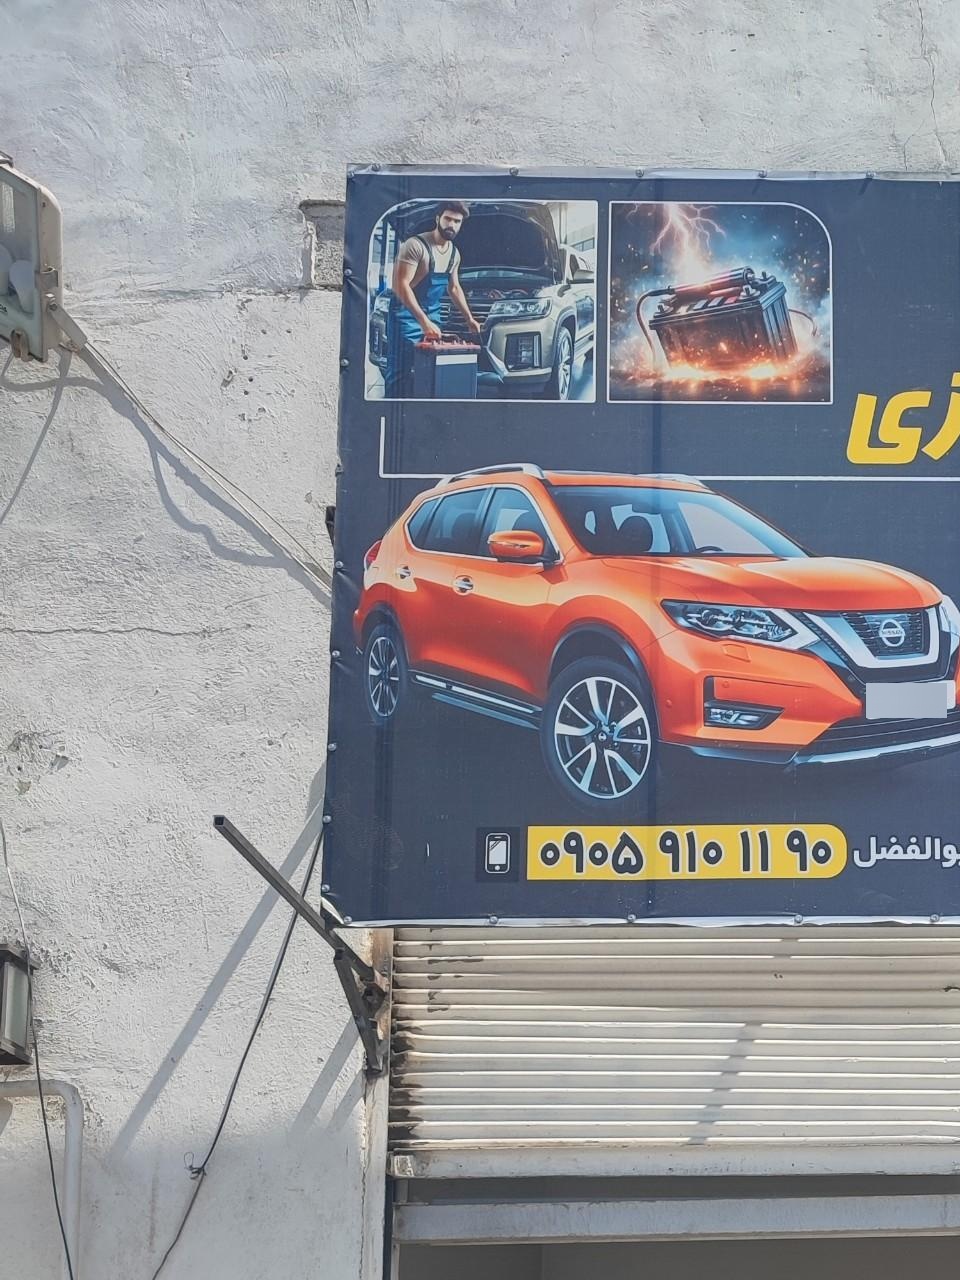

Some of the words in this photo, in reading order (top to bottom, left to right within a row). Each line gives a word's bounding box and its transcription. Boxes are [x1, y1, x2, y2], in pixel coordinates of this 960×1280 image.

[540, 831, 644, 875] ۰۹۰۵
[658, 830, 723, 873] ۹۱۰
[740, 830, 769, 872] ۱۱
[787, 829, 833, 873] ۹۰
